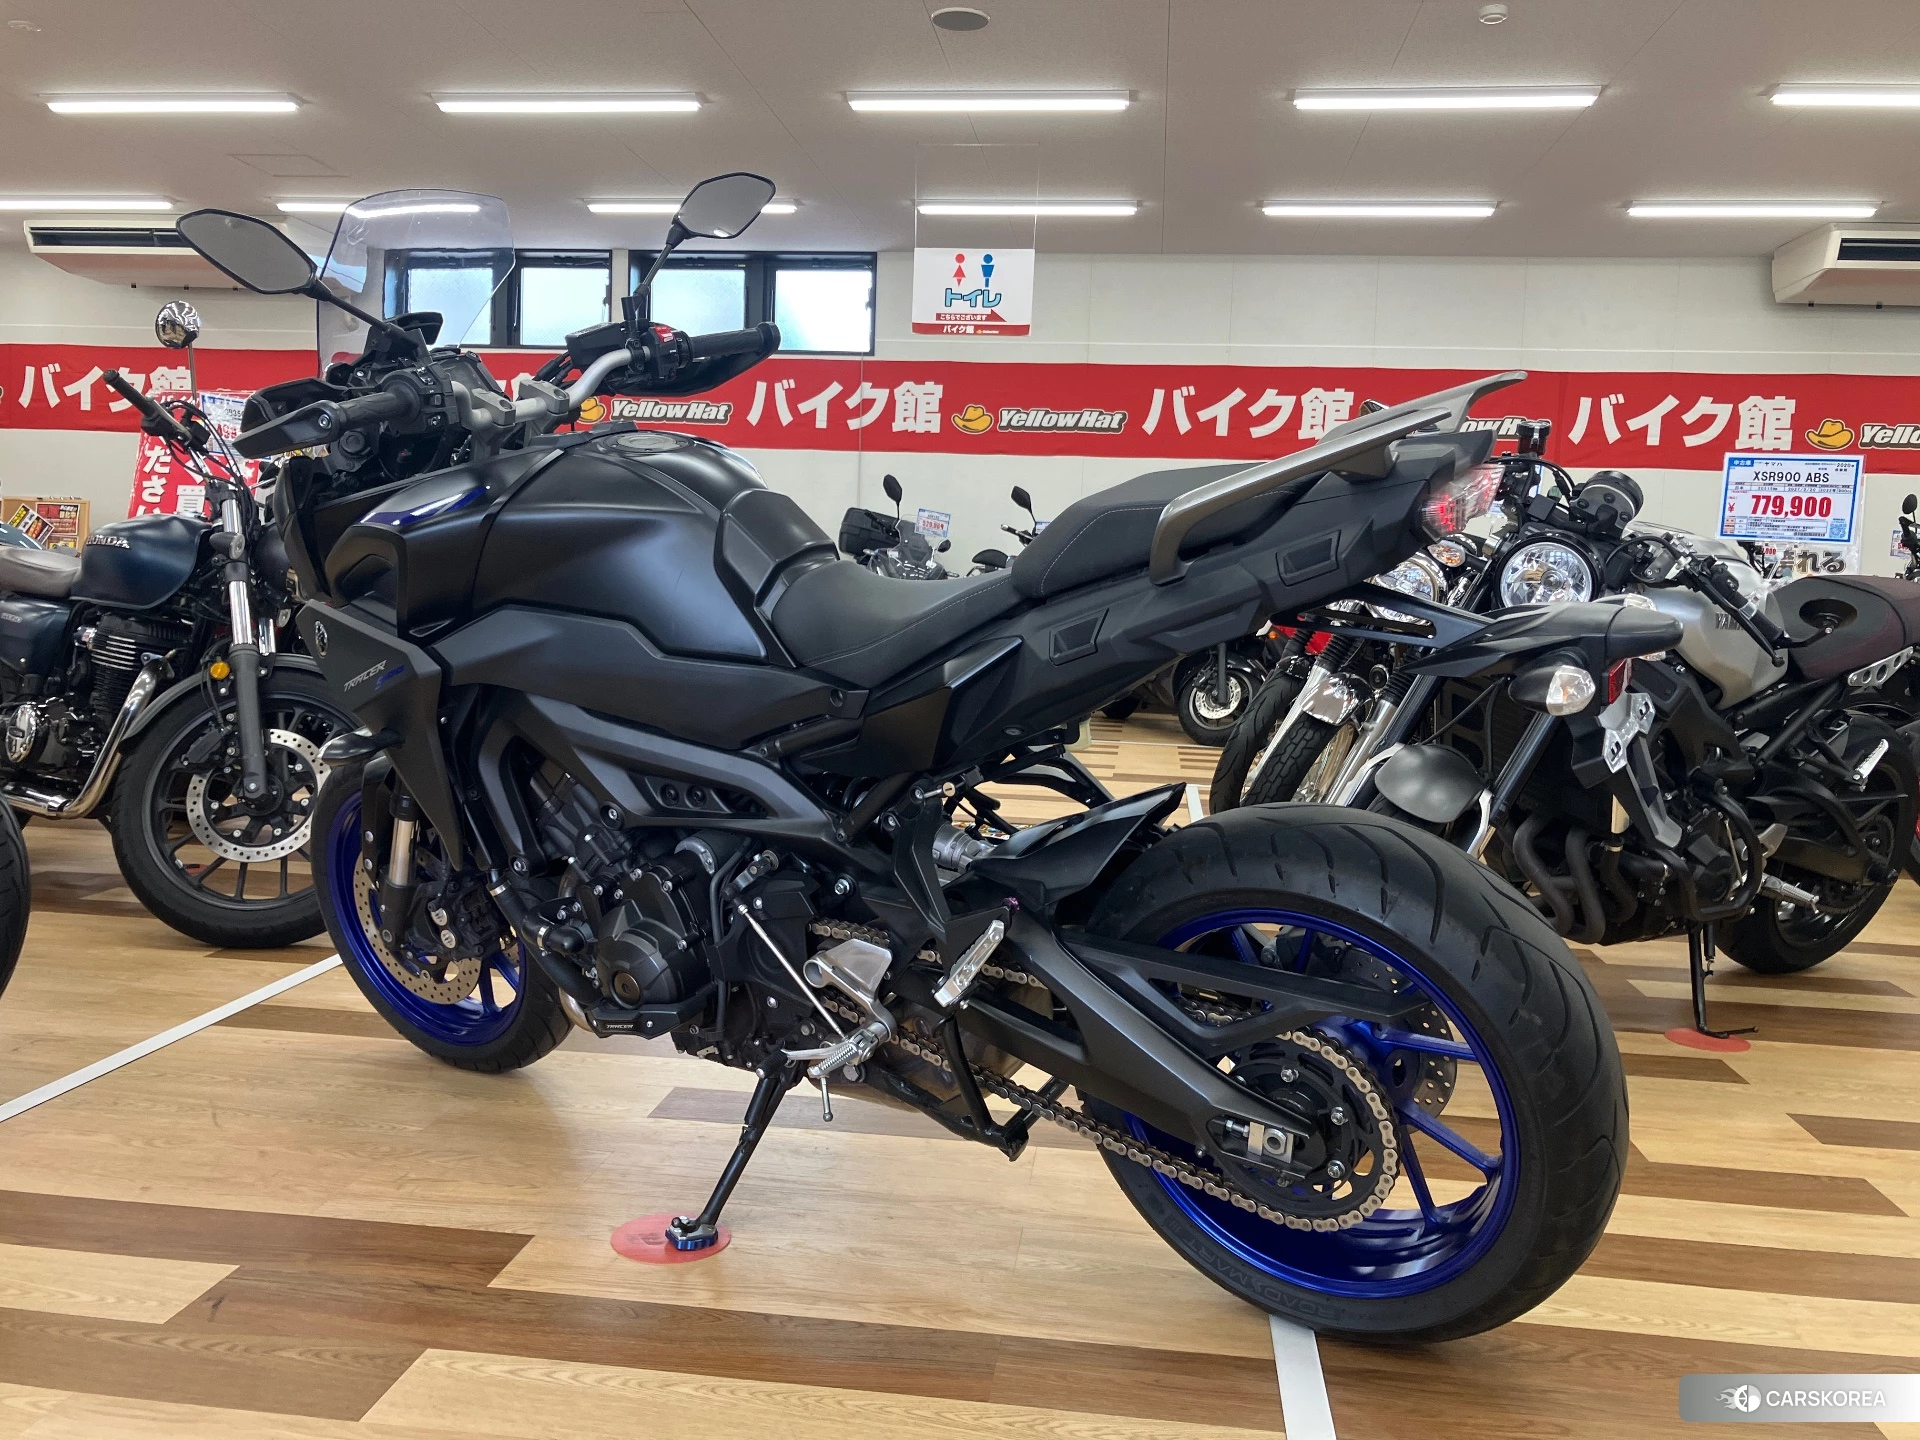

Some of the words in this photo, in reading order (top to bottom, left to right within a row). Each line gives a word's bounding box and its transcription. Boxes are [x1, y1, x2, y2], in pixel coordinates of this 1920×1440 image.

[944, 288, 1002, 308] トイレ
[940, 313, 988, 321] こちらでございます
[611, 399, 730, 421] YellowHat
[746, 379, 943, 434] バイク館
[1142, 386, 1354, 440] バイク館
[998, 409, 1124, 430] YellowHat
[1568, 394, 1796, 450] バイク館
[1753, 471, 1801, 482] XSR900
[1805, 472, 1830, 483] ABS
[1728, 502, 1735, 513] ¥
[1751, 494, 1832, 518] 779,900
[343, 659, 387, 693] TRACER
